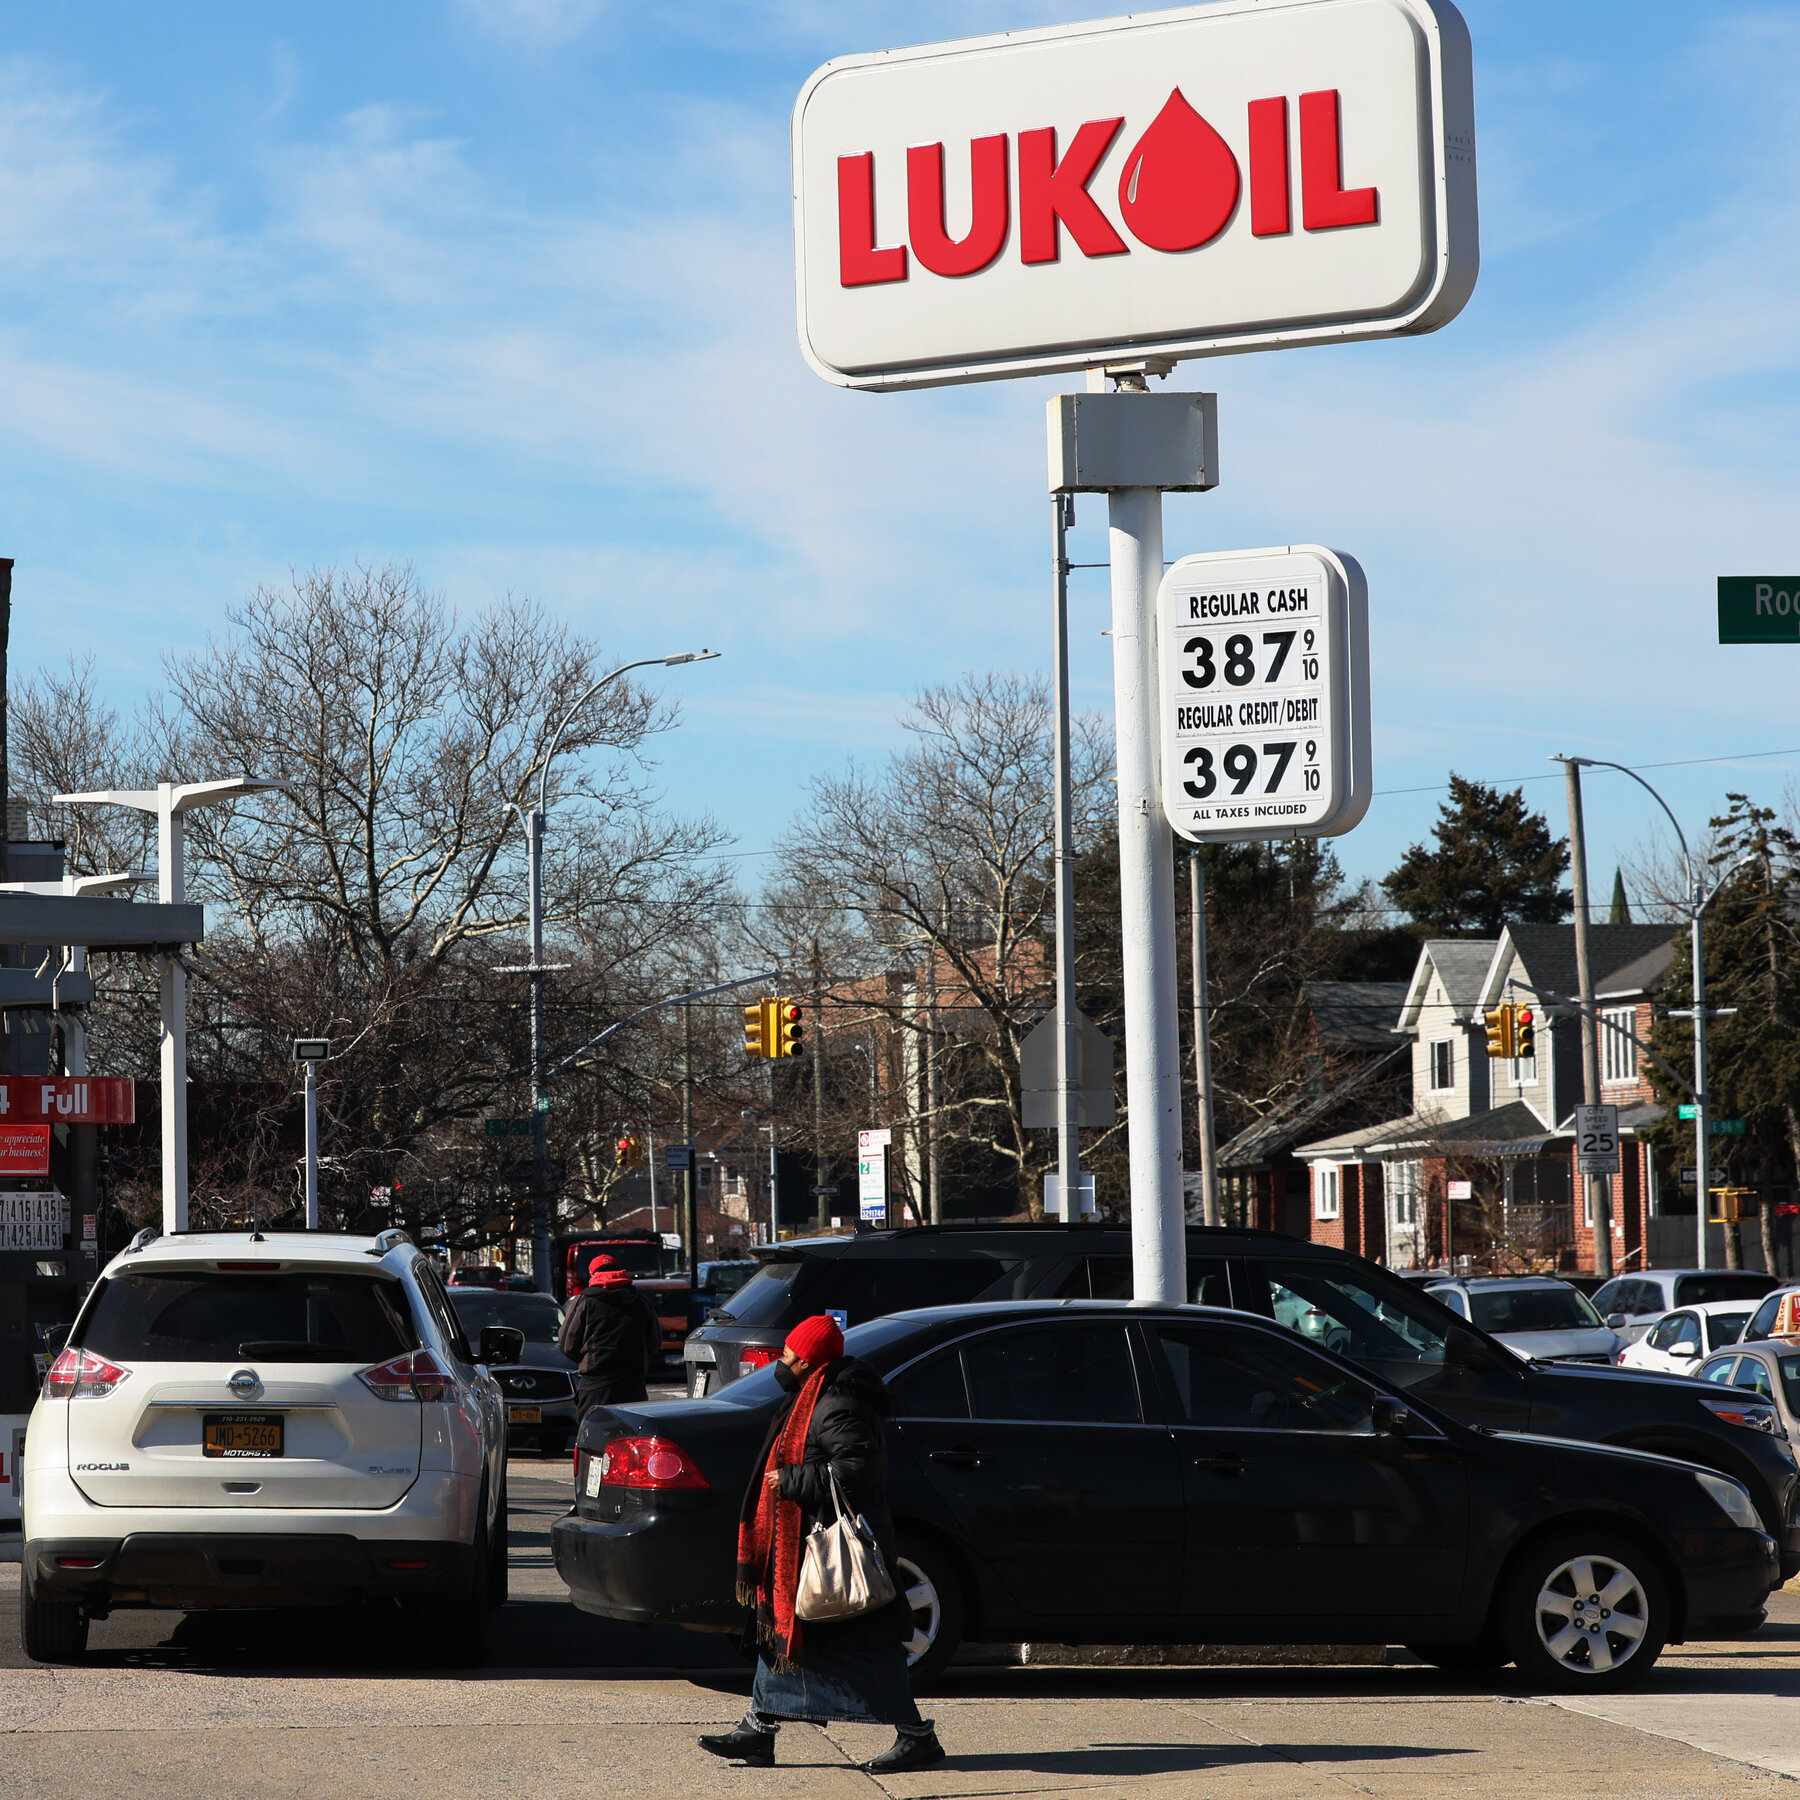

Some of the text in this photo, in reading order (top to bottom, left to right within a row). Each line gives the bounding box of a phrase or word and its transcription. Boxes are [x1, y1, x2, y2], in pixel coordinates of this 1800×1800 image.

[837, 86, 1380, 288] LUKOIL
[1189, 588, 1308, 619] REGULAR CASH
[1181, 630, 1297, 689] 387
[1177, 698, 1318, 730] REGULAR CREDIT/DEBIT
[1183, 741, 1297, 799] 397
[1193, 804, 1307, 821] ALL TAXES INCLUDED
[41, 1084, 88, 1114] Full
[4, 1133, 45, 1146] appreciate
[8, 1146, 46, 1157] business!
[1583, 1133, 1614, 1153] 25
[76, 1463, 130, 1471] ROGUE
